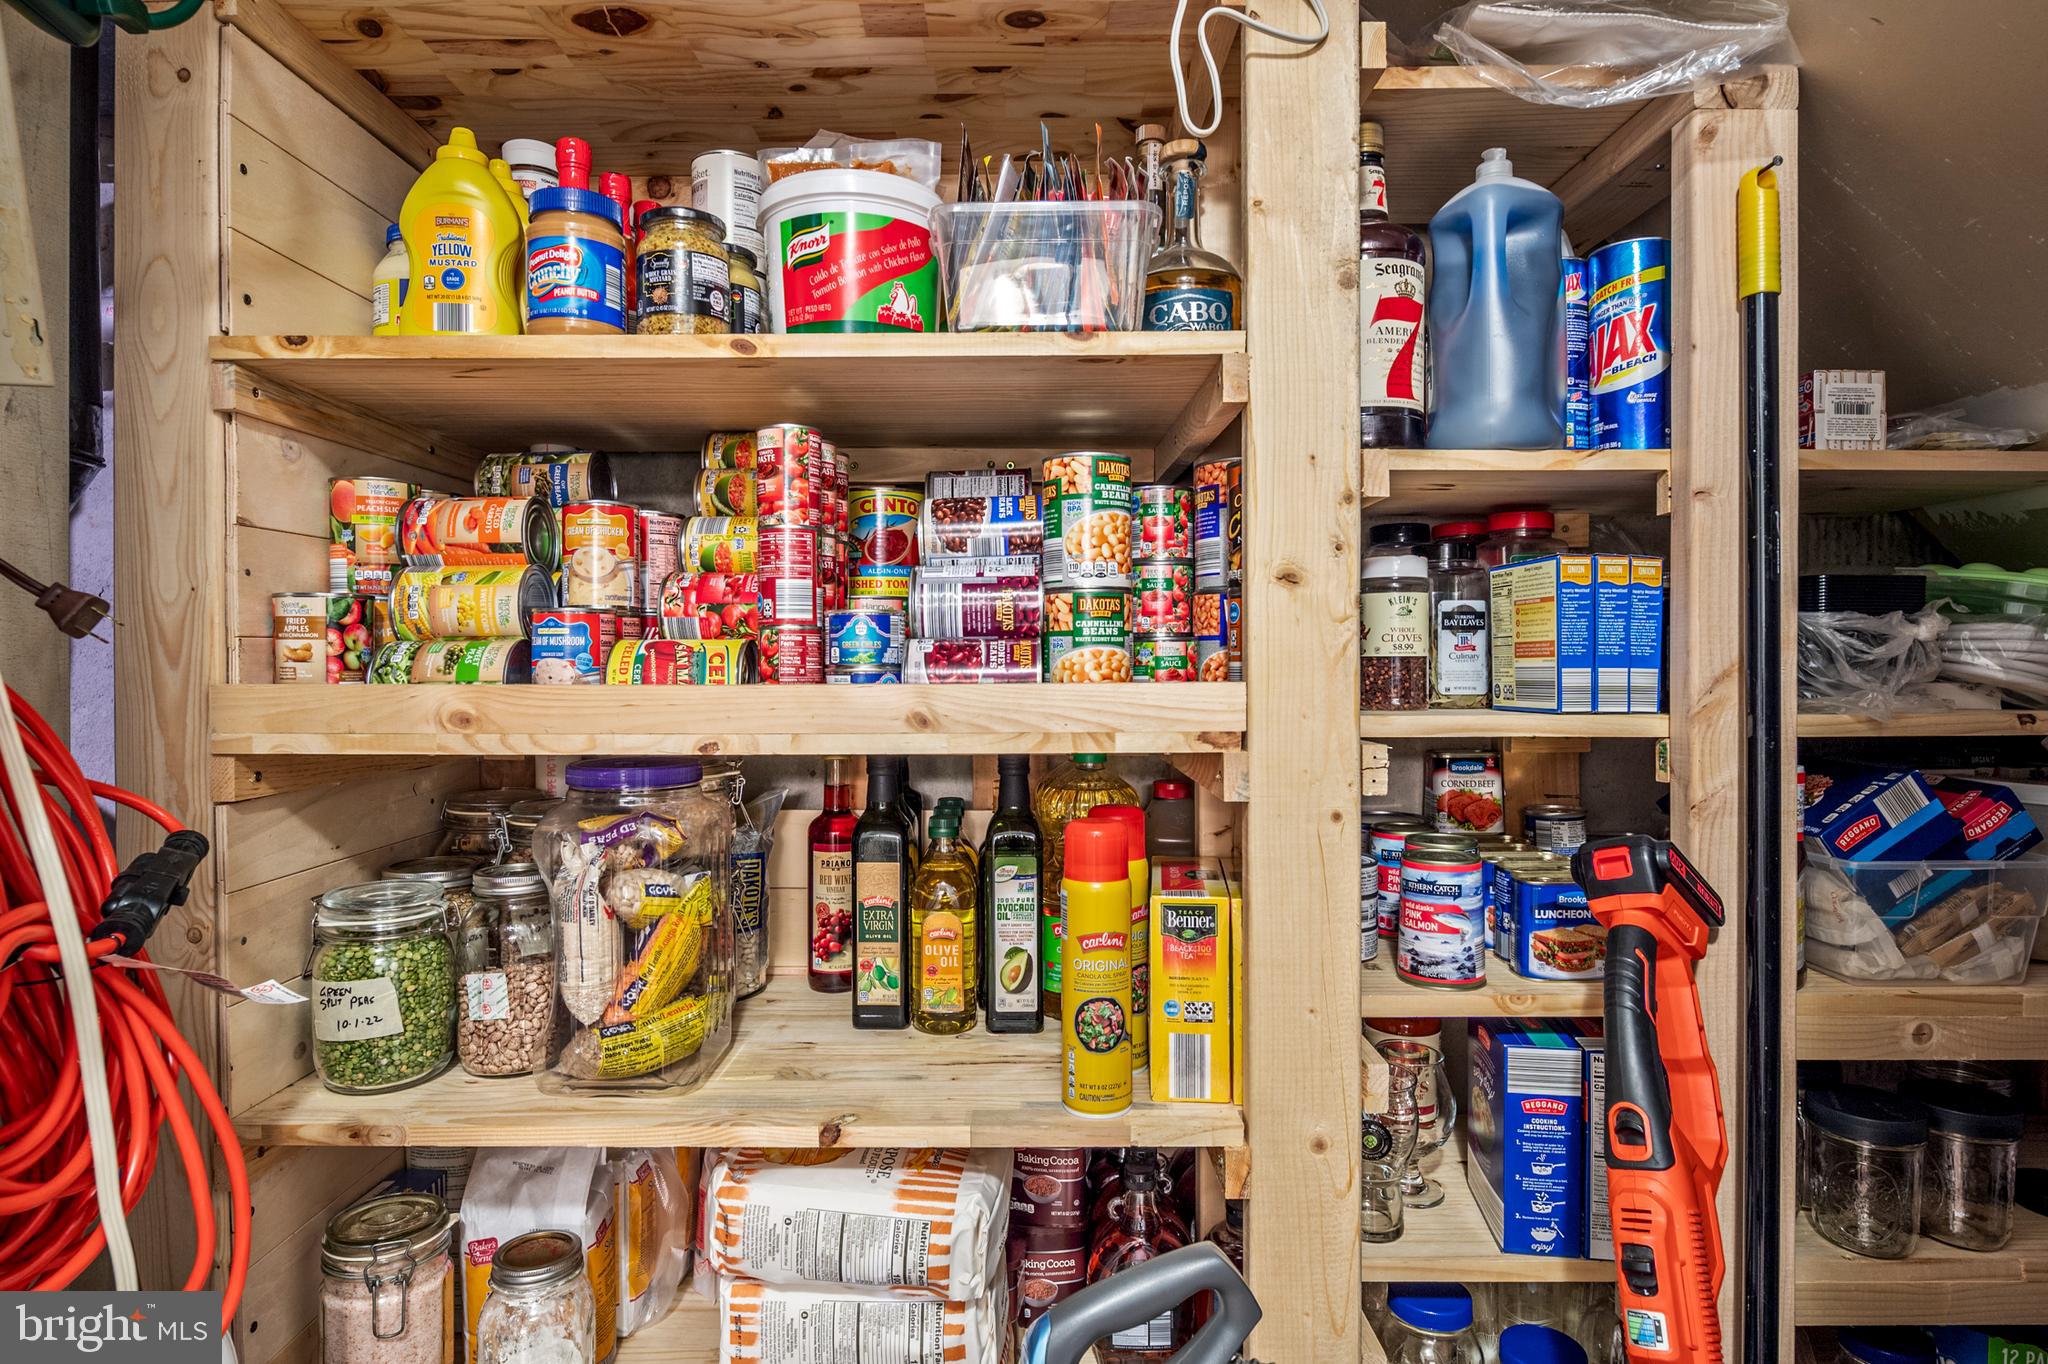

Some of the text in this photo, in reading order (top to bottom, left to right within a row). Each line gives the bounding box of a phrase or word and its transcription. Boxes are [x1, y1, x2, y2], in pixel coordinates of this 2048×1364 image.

[436, 217, 469, 227] BURMAN'S
[432, 244, 472, 258] YELLOW
[788, 234, 828, 258] Knorr
[808, 236, 921, 286] Caldo de con Sabor de Pollo
[812, 281, 838, 300] Tomato
[883, 254, 910, 270] Chicken
[910, 251, 926, 263] Flavor
[1375, 262, 1424, 284] Seagram's
[554, 287, 598, 300] PEANUT BUTTER
[1150, 301, 1228, 325] CABO
[1370, 294, 1424, 401] 7
[1611, 353, 1657, 374] BLEACH
[1098, 461, 1131, 476] DAKOTA'S
[554, 465, 562, 485] GREEN
[1101, 490, 1130, 500] BEANS
[860, 498, 918, 515] CENTO
[1066, 505, 1082, 513] BPA
[485, 503, 497, 534] CARROTS
[1567, 566, 1585, 574] ONION
[1605, 566, 1623, 574] ONION
[1638, 567, 1656, 575] ONION
[1078, 598, 1121, 610] DAKOTA'S
[1387, 595, 1419, 607] KLEIN'S
[284, 625, 310, 633] APPLES
[1082, 627, 1119, 636] BEANS
[549, 635, 585, 646] MUSHROOM
[1381, 632, 1423, 643] CLOVES
[1392, 643, 1414, 651] $8.99
[619, 640, 636, 675] PEELED
[675, 644, 687, 667] SAN
[1448, 652, 1480, 662] Culinary
[1160, 659, 1182, 667] SAUCE
[1451, 764, 1484, 772] Brookdale
[1441, 779, 1477, 788] CORNED
[1968, 805, 2008, 836] REGGANO
[1840, 817, 1877, 848] REGGANO
[820, 859, 851, 869] PRIANO
[819, 875, 833, 885] RED
[745, 860, 761, 928] DAKOTA'S
[864, 896, 894, 909] carlini
[997, 904, 1035, 912] AVOCADO
[1415, 903, 1435, 912] alaska
[863, 910, 894, 921] EXTRA
[997, 912, 1010, 921] OIL
[1168, 912, 1210, 928] Benner
[1405, 909, 1422, 919] PINK
[1534, 909, 1592, 919] LUNCHEON
[863, 920, 894, 931] VIRGIN
[1404, 917, 1439, 931] SALMON
[928, 928, 956, 940] carlini
[1081, 931, 1126, 949] carlini
[925, 944, 959, 956] OLIVE
[940, 957, 959, 967] OIL
[1073, 958, 1129, 972] ORIGINAL
[319, 986, 352, 996] GREEN
[319, 995, 375, 1011] SPLIT PEAS
[1079, 1093, 1101, 1102] CAUTION
[1524, 1101, 1565, 1111] REGGANO
[1018, 1153, 1079, 1167] Baking Cocoa
[893, 1219, 903, 1255] Calories
[470, 1241, 497, 1253] Baker's
[917, 1222, 930, 1268] Nutrition
[470, 1252, 493, 1266] Corne
[1047, 1258, 1076, 1269] Cocoa
[908, 1302, 918, 1341] Calories
[933, 1302, 944, 1343] Nutrition
